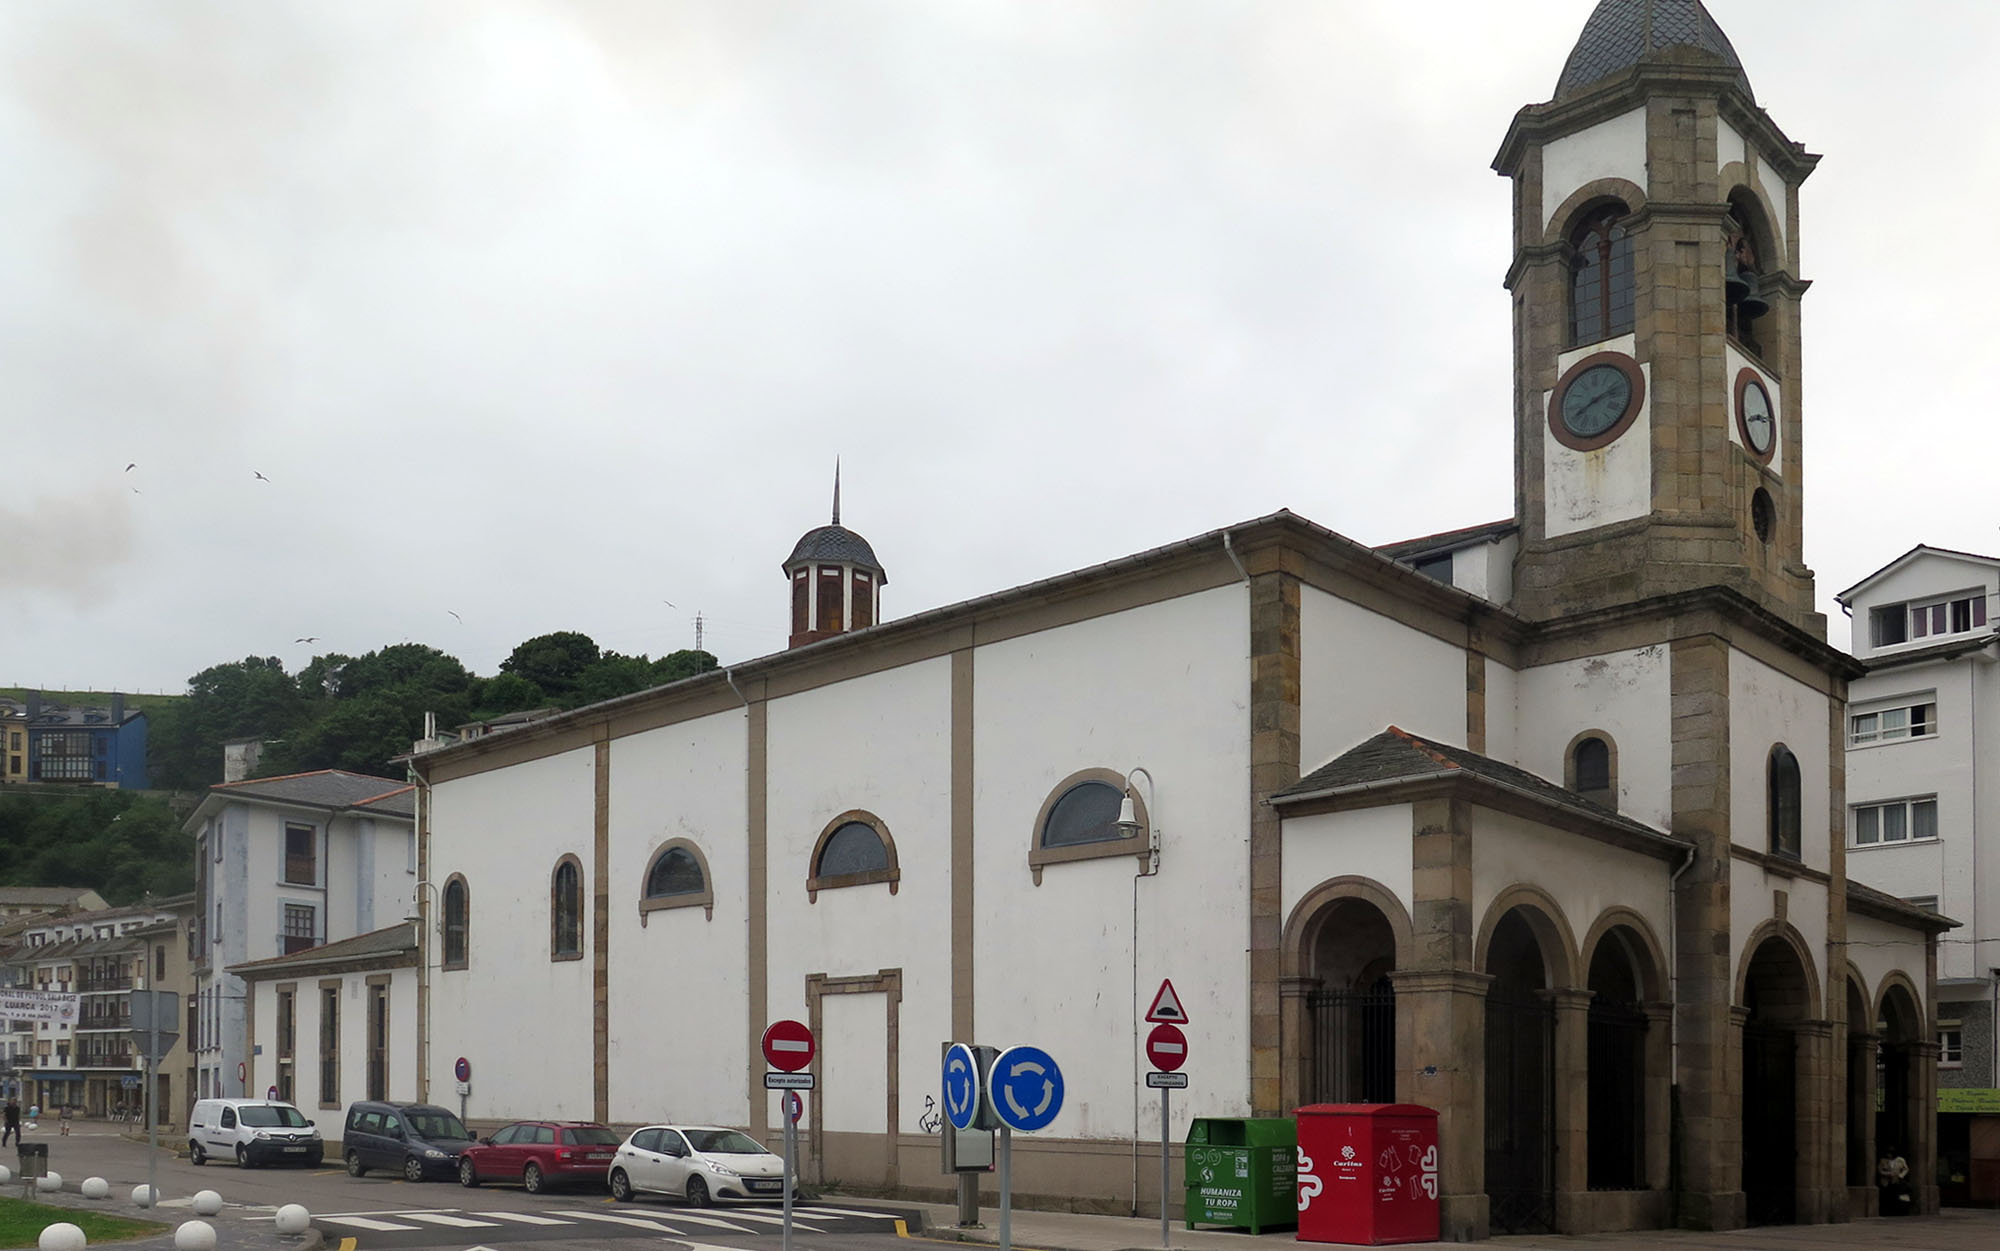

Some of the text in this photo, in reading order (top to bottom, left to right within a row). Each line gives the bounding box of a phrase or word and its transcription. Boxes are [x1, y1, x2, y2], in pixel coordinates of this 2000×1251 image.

[5, 1001, 58, 1012] LUARCA 2017
[768, 1076, 785, 1084] Excepto
[1200, 1187, 1242, 1197] HUMANIZA
[1205, 1198, 1238, 1208] TU ROPA
